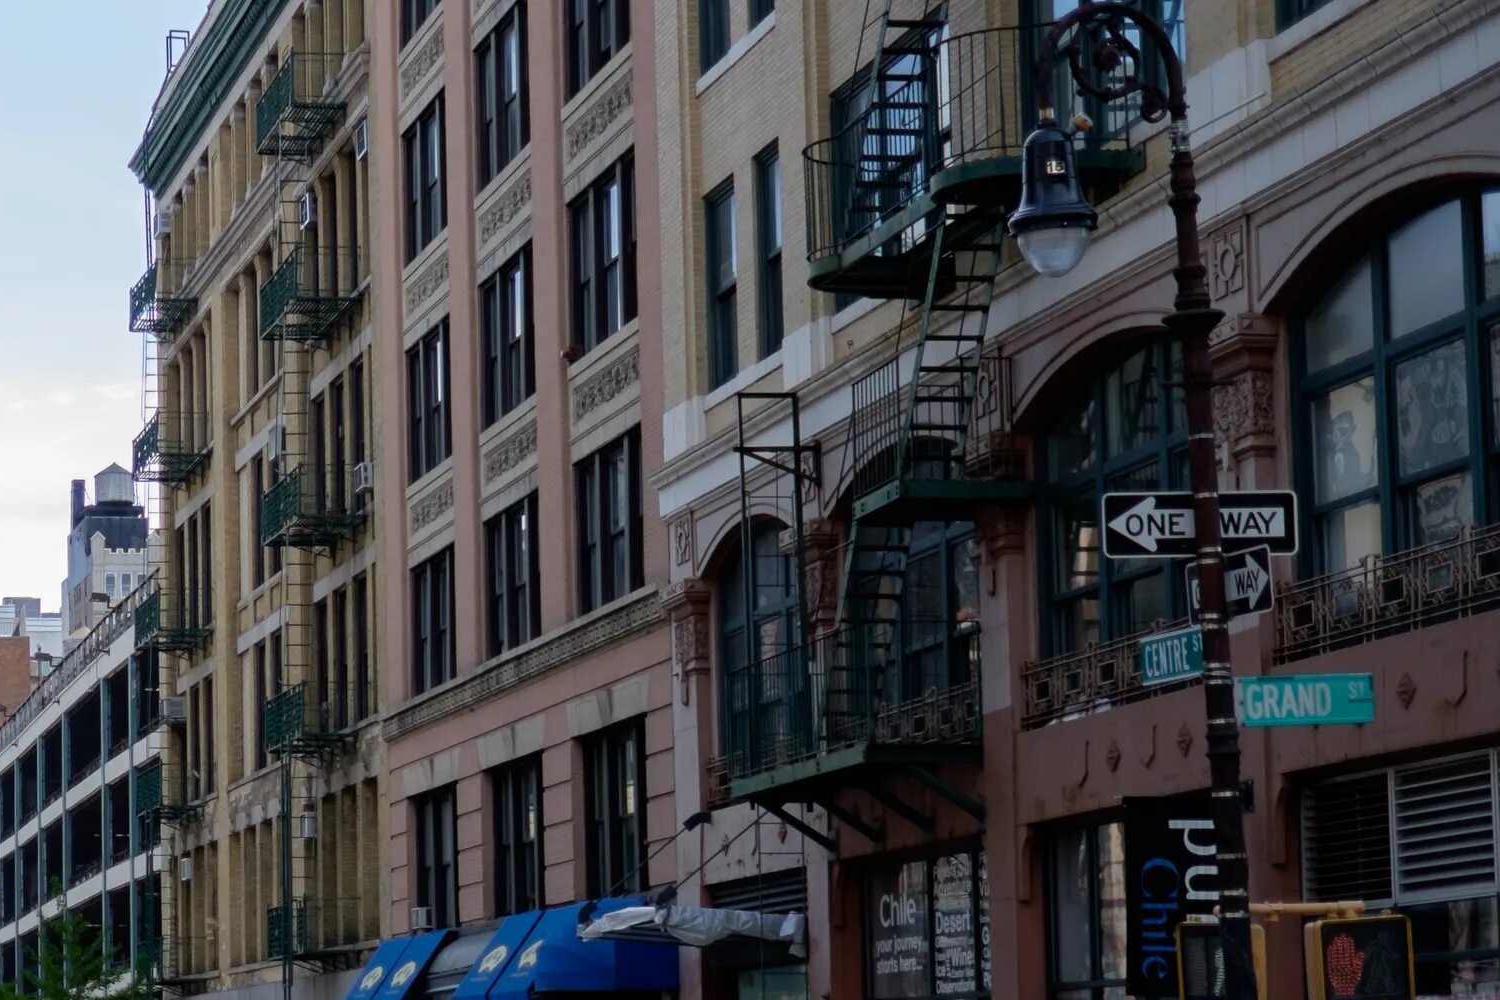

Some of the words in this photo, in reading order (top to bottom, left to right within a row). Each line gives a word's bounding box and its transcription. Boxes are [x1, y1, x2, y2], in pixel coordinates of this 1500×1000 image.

[1125, 513, 1185, 537] ONE
[1220, 511, 1277, 535] WAY
[1234, 568, 1260, 596] WAY
[1144, 635, 1190, 677] CENTRE
[1246, 682, 1332, 720] GRAND
[1347, 681, 1366, 700] ST
[879, 894, 917, 928] Chile
[935, 911, 971, 935] Desert
[1140, 857, 1181, 980] Chile
[875, 940, 893, 958] your
[893, 934, 923, 955] journey
[876, 957, 899, 975] starts
